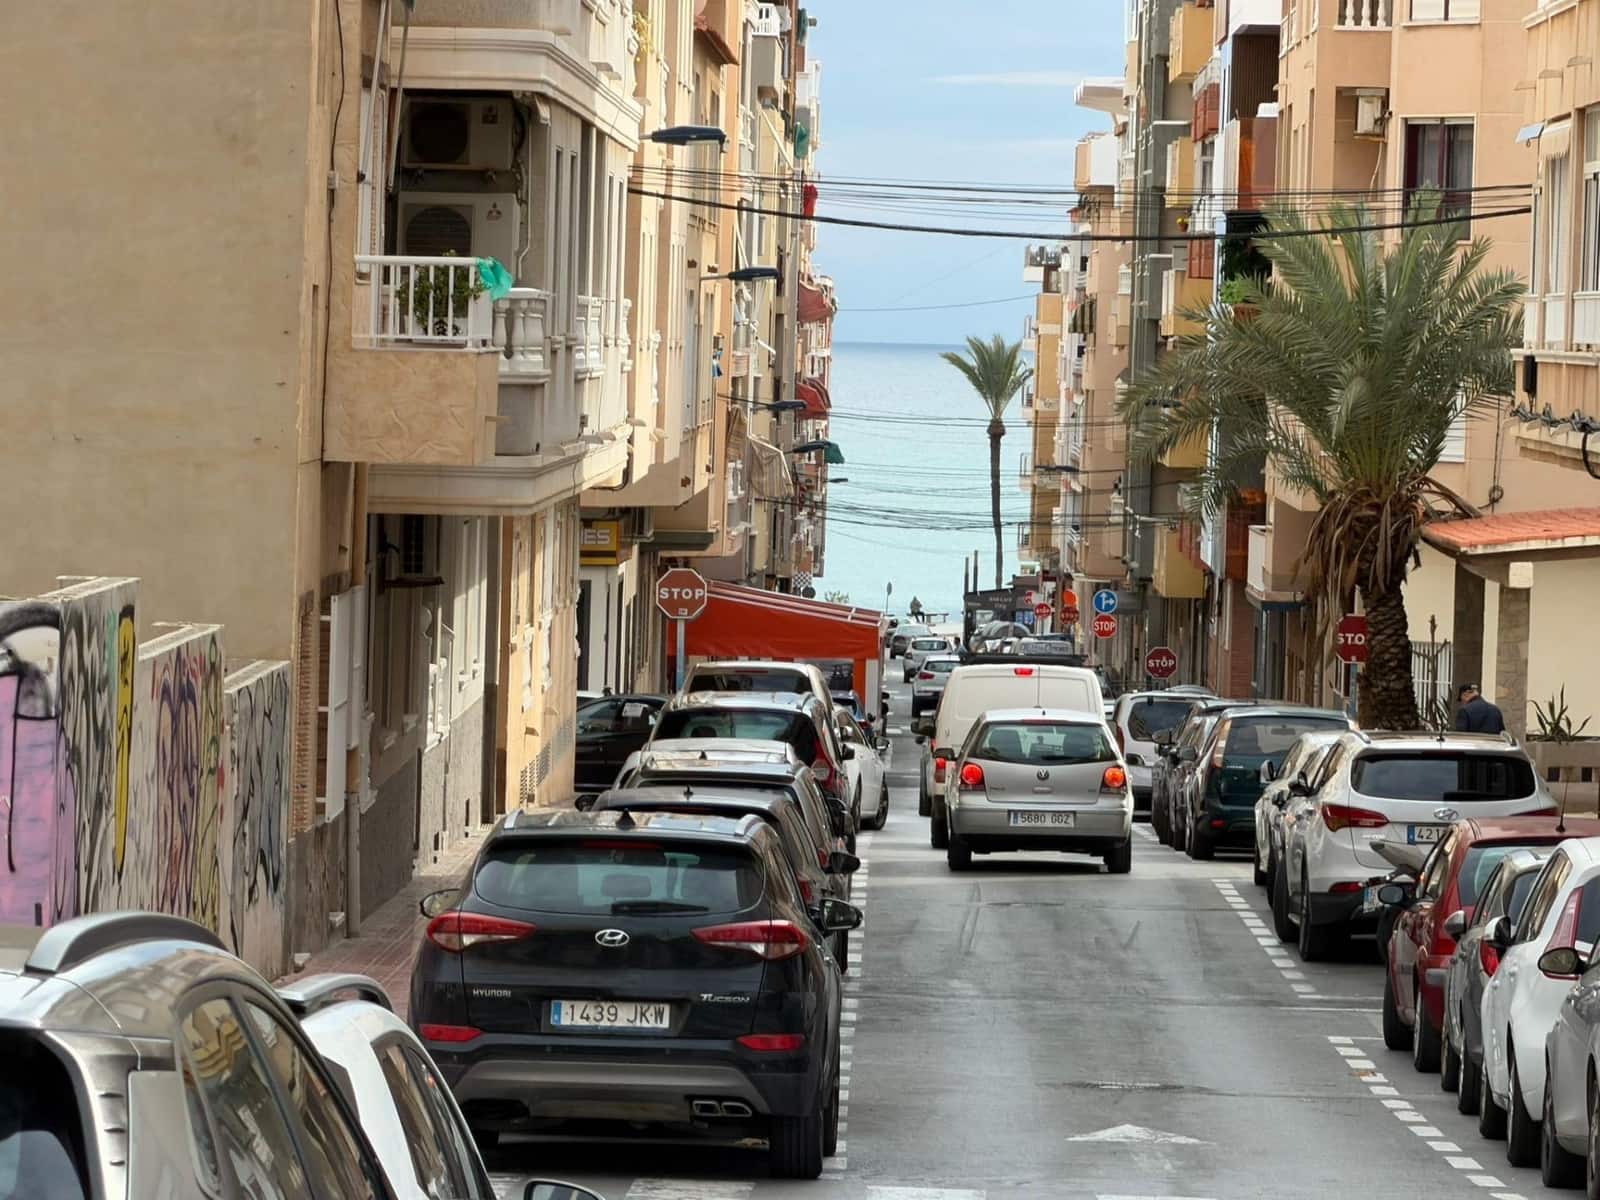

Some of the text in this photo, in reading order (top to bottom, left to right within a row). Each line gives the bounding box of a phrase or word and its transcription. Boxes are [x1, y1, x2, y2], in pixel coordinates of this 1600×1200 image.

[660, 587, 705, 600] STOP
[1094, 622, 1115, 631] STOP
[1336, 633, 1365, 645] STO
[1148, 658, 1175, 668] STOP
[1417, 828, 1445, 841] 421
[472, 988, 511, 998] HYUNDAI
[570, 1004, 665, 1024] 1439 JKW
